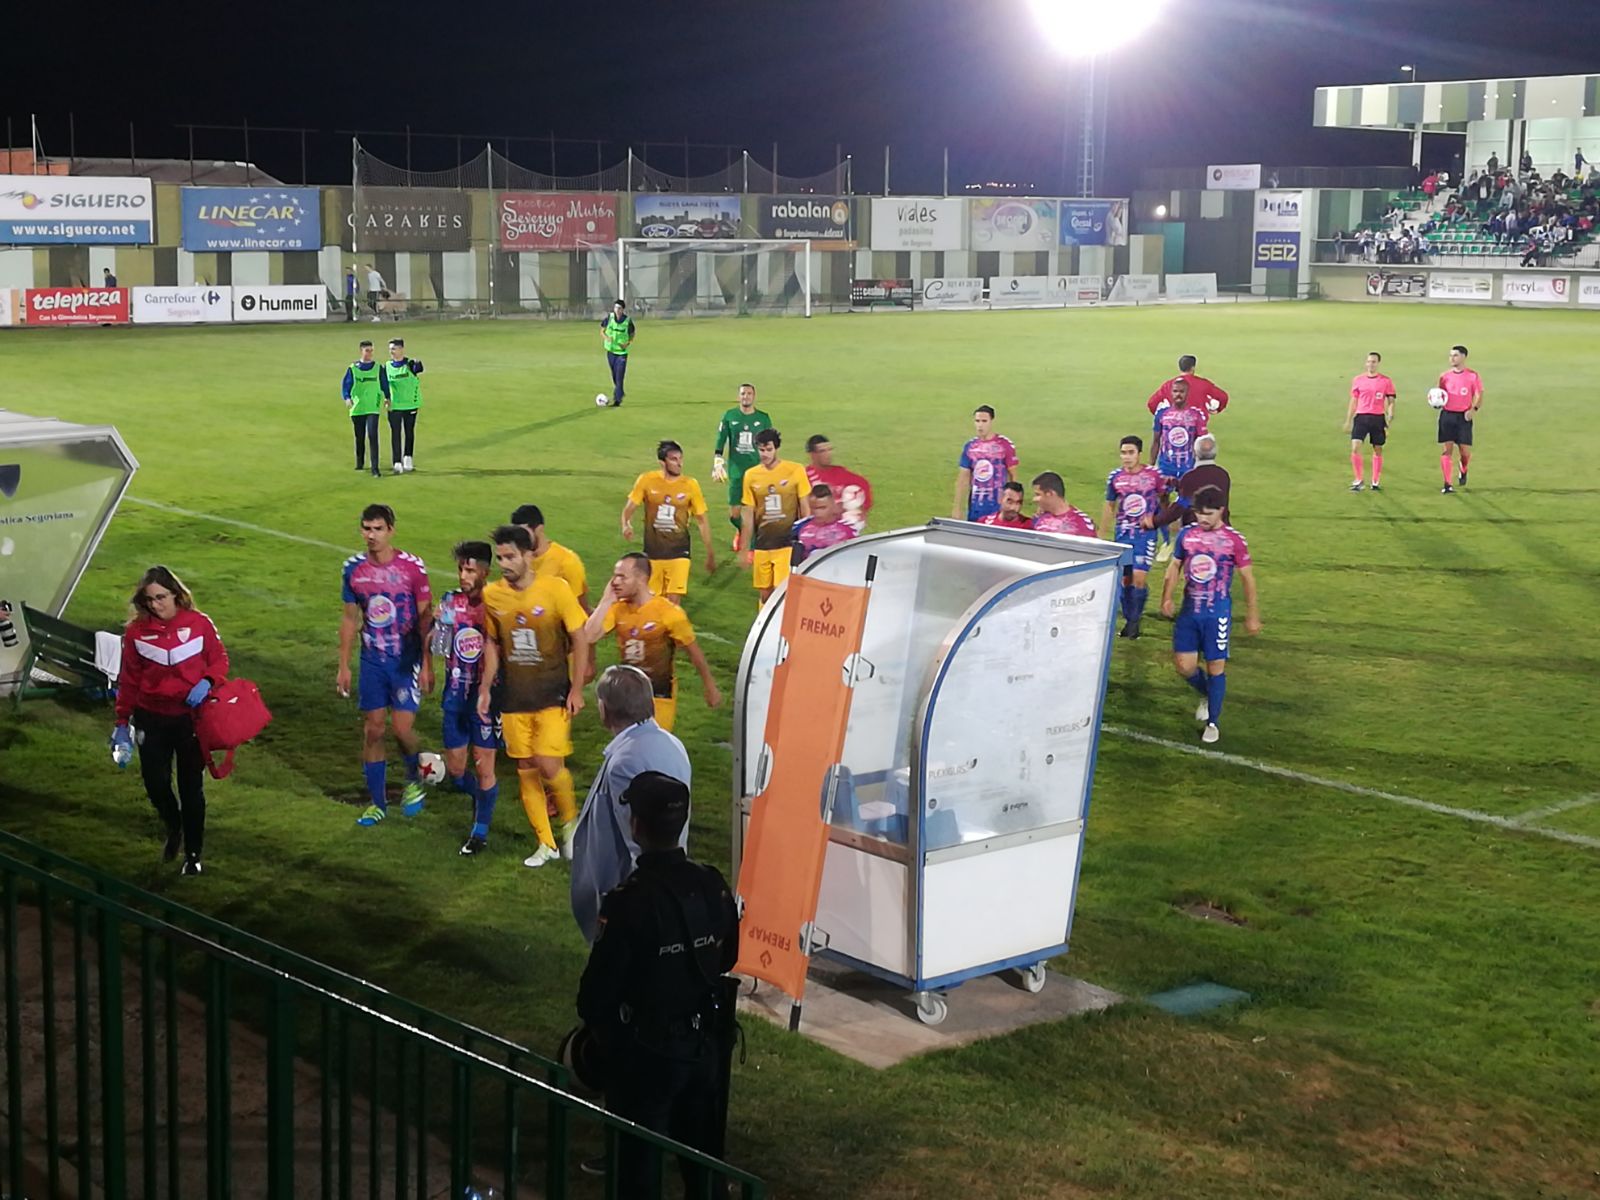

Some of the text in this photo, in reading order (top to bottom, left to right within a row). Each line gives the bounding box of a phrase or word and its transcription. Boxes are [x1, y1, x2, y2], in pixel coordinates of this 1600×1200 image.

[50, 193, 146, 209] SIGUERO
[772, 200, 830, 218] rabalan
[198, 204, 296, 220] LINECAR
[12, 223, 136, 238] www.siguero.net
[505, 221, 557, 241] Sanz
[206, 237, 302, 249] www.linecar.es
[32, 288, 121, 314] telepizza
[144, 292, 197, 305] Carrefour
[259, 293, 318, 312] hummel
[800, 616, 846, 640] FREMAP
[747, 925, 792, 953] FREMAP
